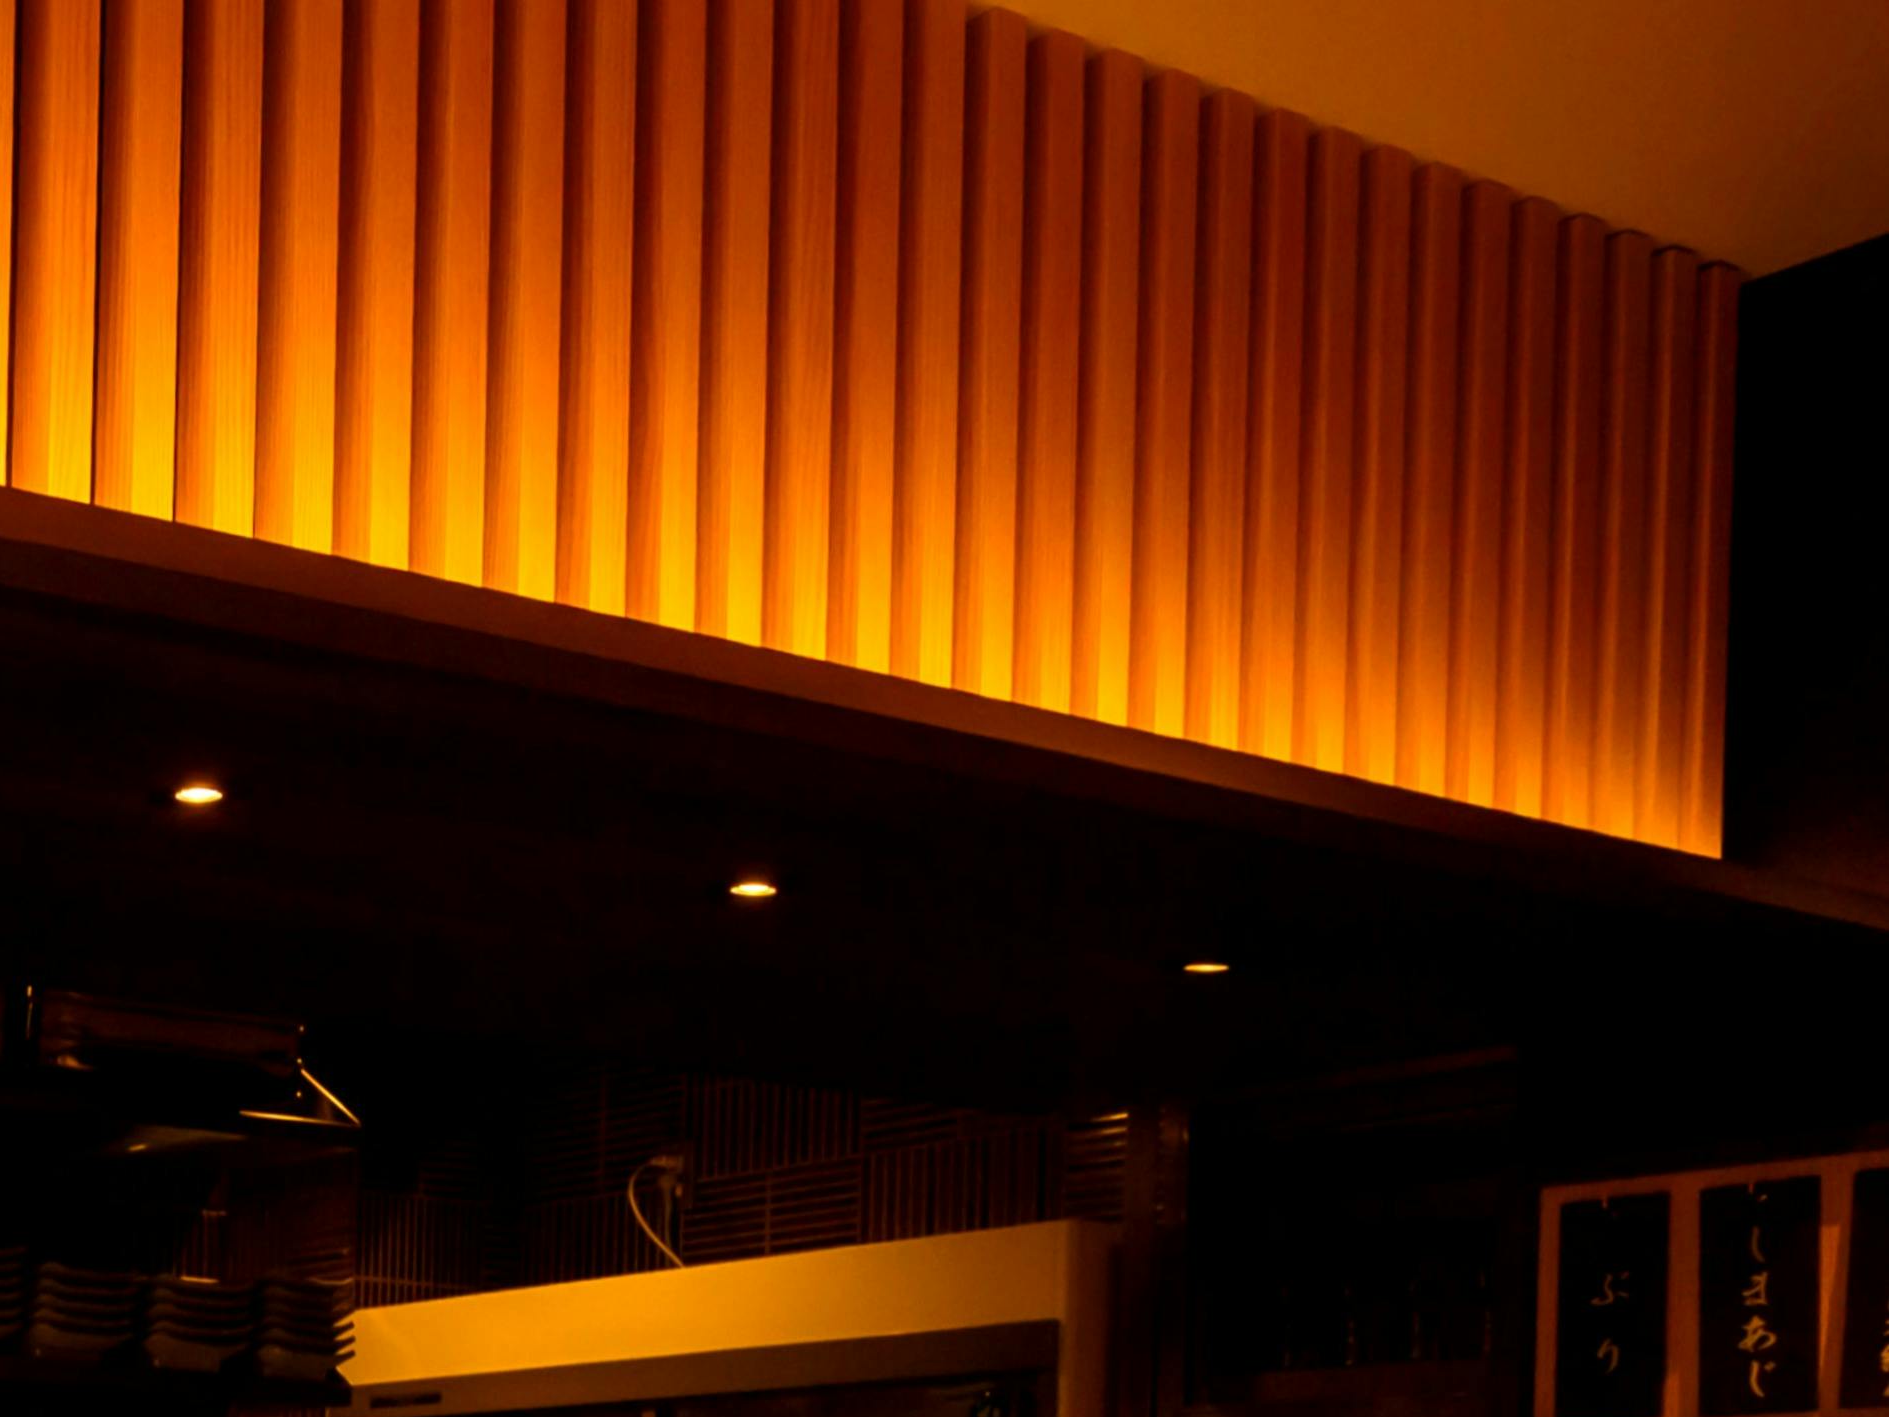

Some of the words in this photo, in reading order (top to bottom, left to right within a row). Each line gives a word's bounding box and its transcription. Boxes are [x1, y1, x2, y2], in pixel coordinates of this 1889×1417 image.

[1589, 1270, 1631, 1374] ぶり
[1736, 1226, 1779, 1399] しまあじ
